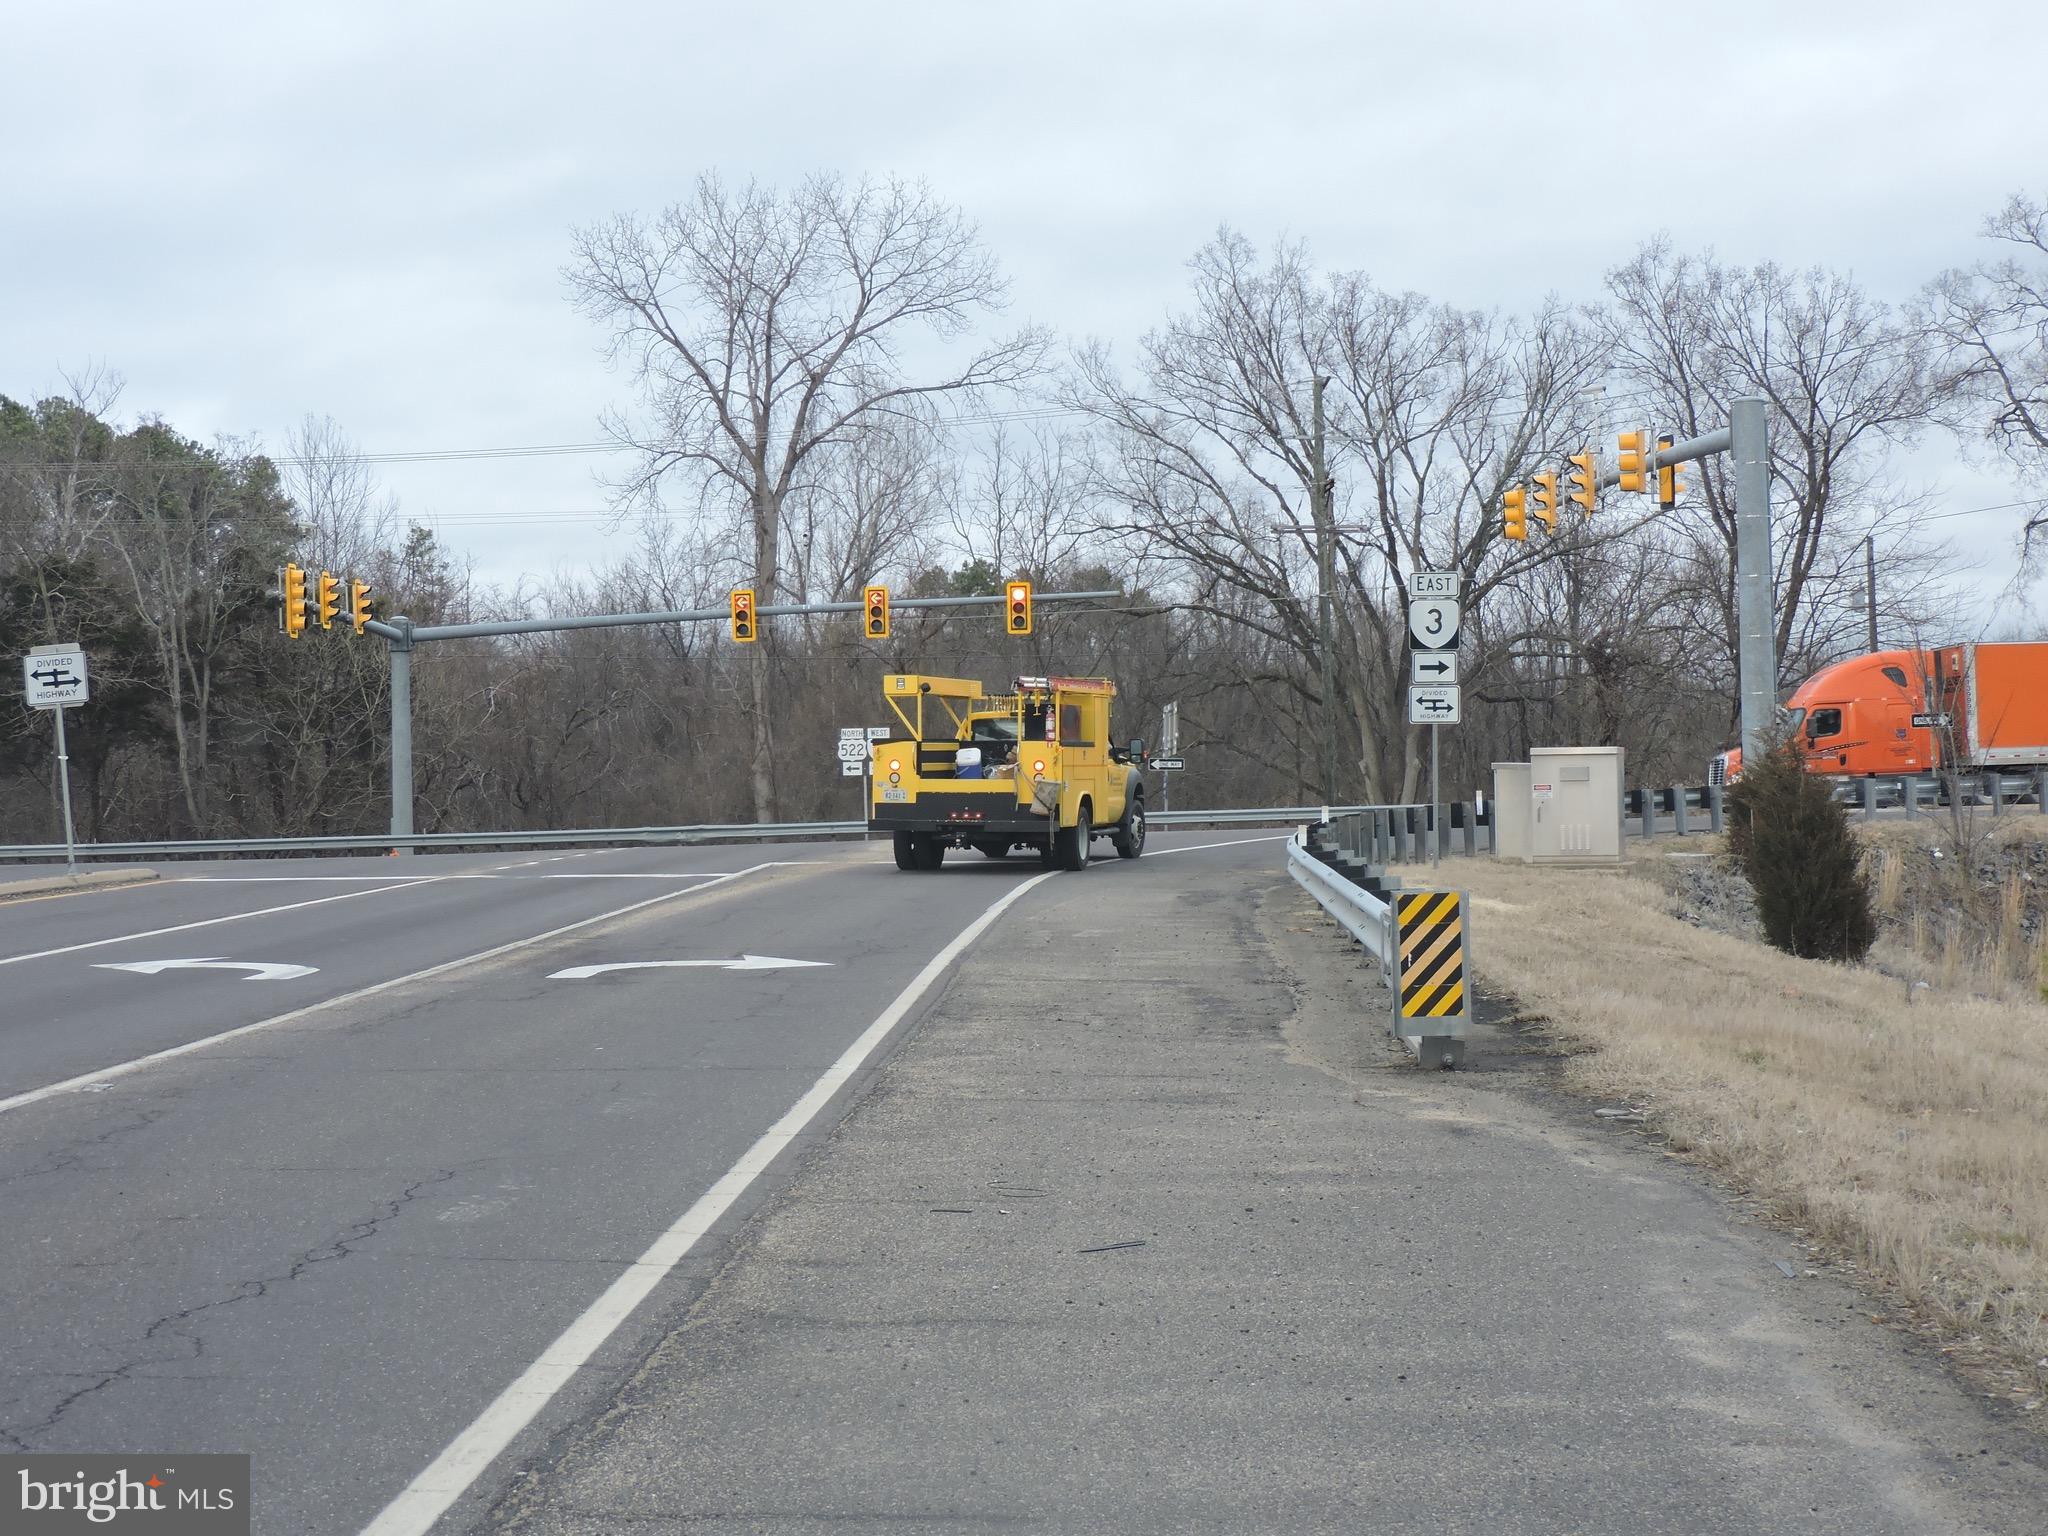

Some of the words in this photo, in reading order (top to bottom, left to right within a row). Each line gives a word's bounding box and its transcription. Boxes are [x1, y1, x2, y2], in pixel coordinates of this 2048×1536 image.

[1416, 575, 1452, 592] EAST
[1425, 608, 1443, 635] 3
[36, 657, 73, 668] DIVIDED
[36, 689, 78, 699] HIGHWAY
[842, 729, 863, 738] NORTH
[871, 728, 887, 737] WEST
[840, 743, 864, 757] 522
